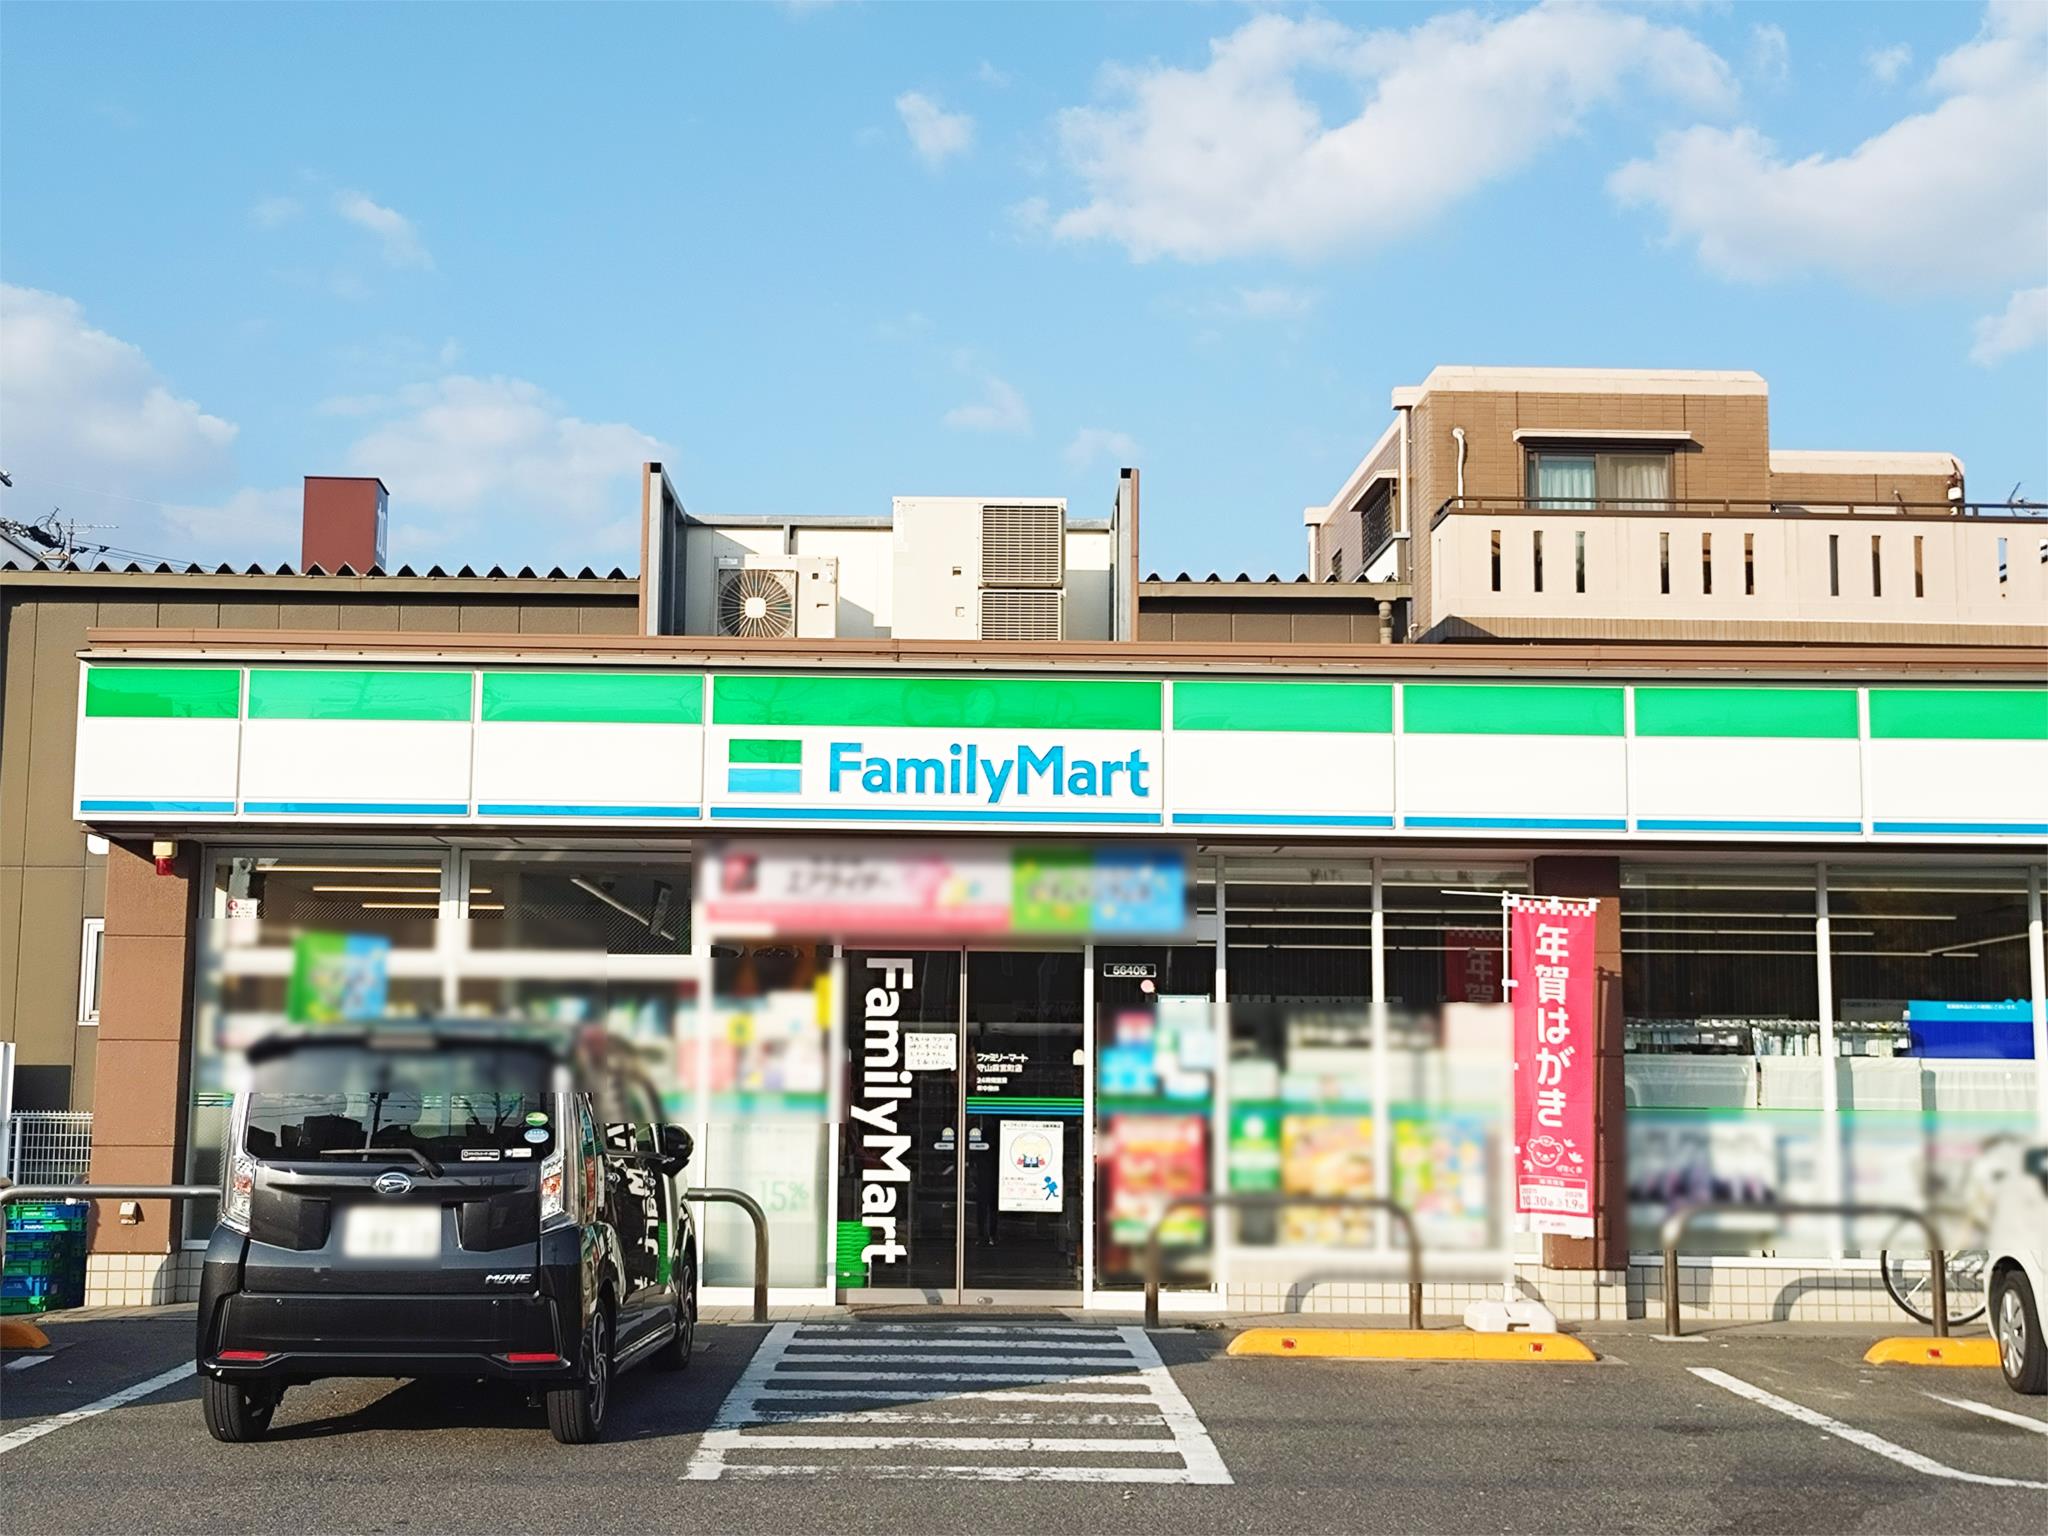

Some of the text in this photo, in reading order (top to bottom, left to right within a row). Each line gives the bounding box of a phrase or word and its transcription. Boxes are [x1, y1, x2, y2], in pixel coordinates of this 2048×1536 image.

[829, 742, 1150, 804] FamilyMart
[1113, 965, 1147, 975] 56406
[1535, 923, 1576, 1128] 年賀はがき
[976, 1053, 1029, 1063] ファミリーマート
[850, 958, 913, 1264] FamilyMart
